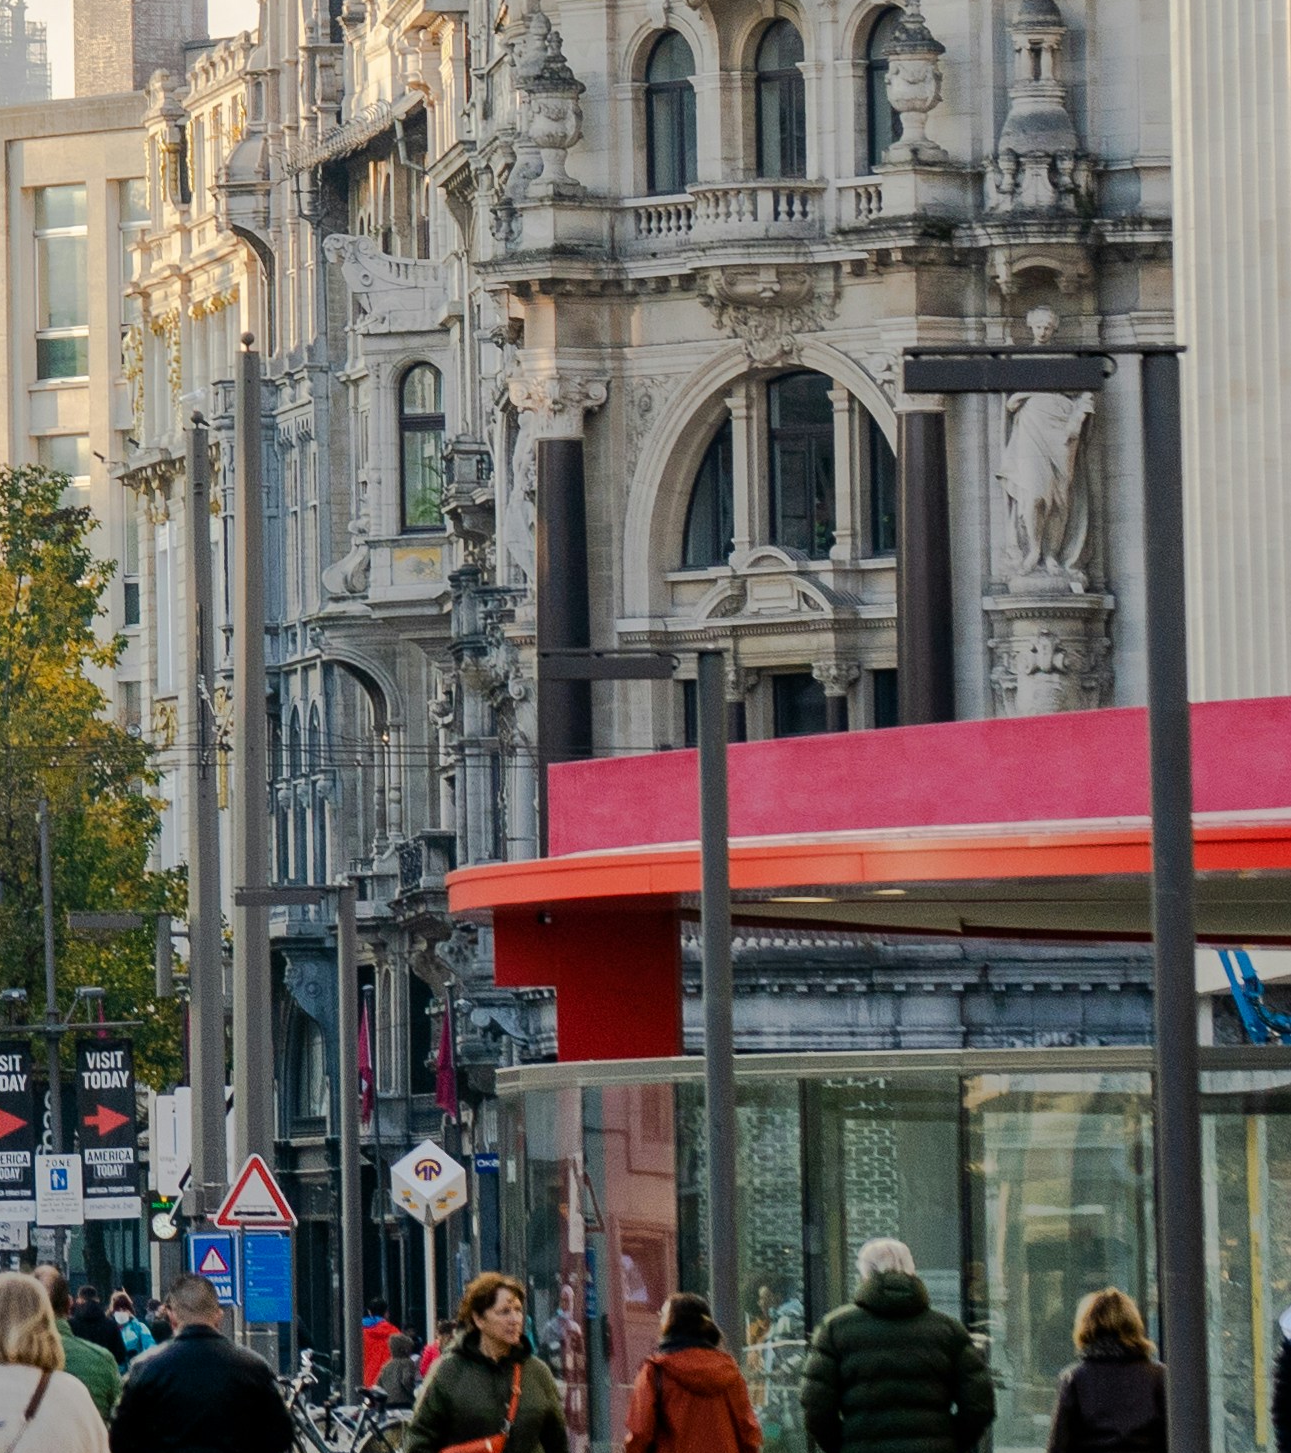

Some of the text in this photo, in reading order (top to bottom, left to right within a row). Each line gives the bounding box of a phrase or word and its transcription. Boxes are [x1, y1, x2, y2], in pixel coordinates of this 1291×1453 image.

[85, 1051, 124, 1069] VISIT
[82, 1071, 130, 1090] TODAY
[45, 1159, 71, 1167] ZONE
[87, 1149, 132, 1163] AMERICA
[96, 1163, 124, 1177] TODAY
